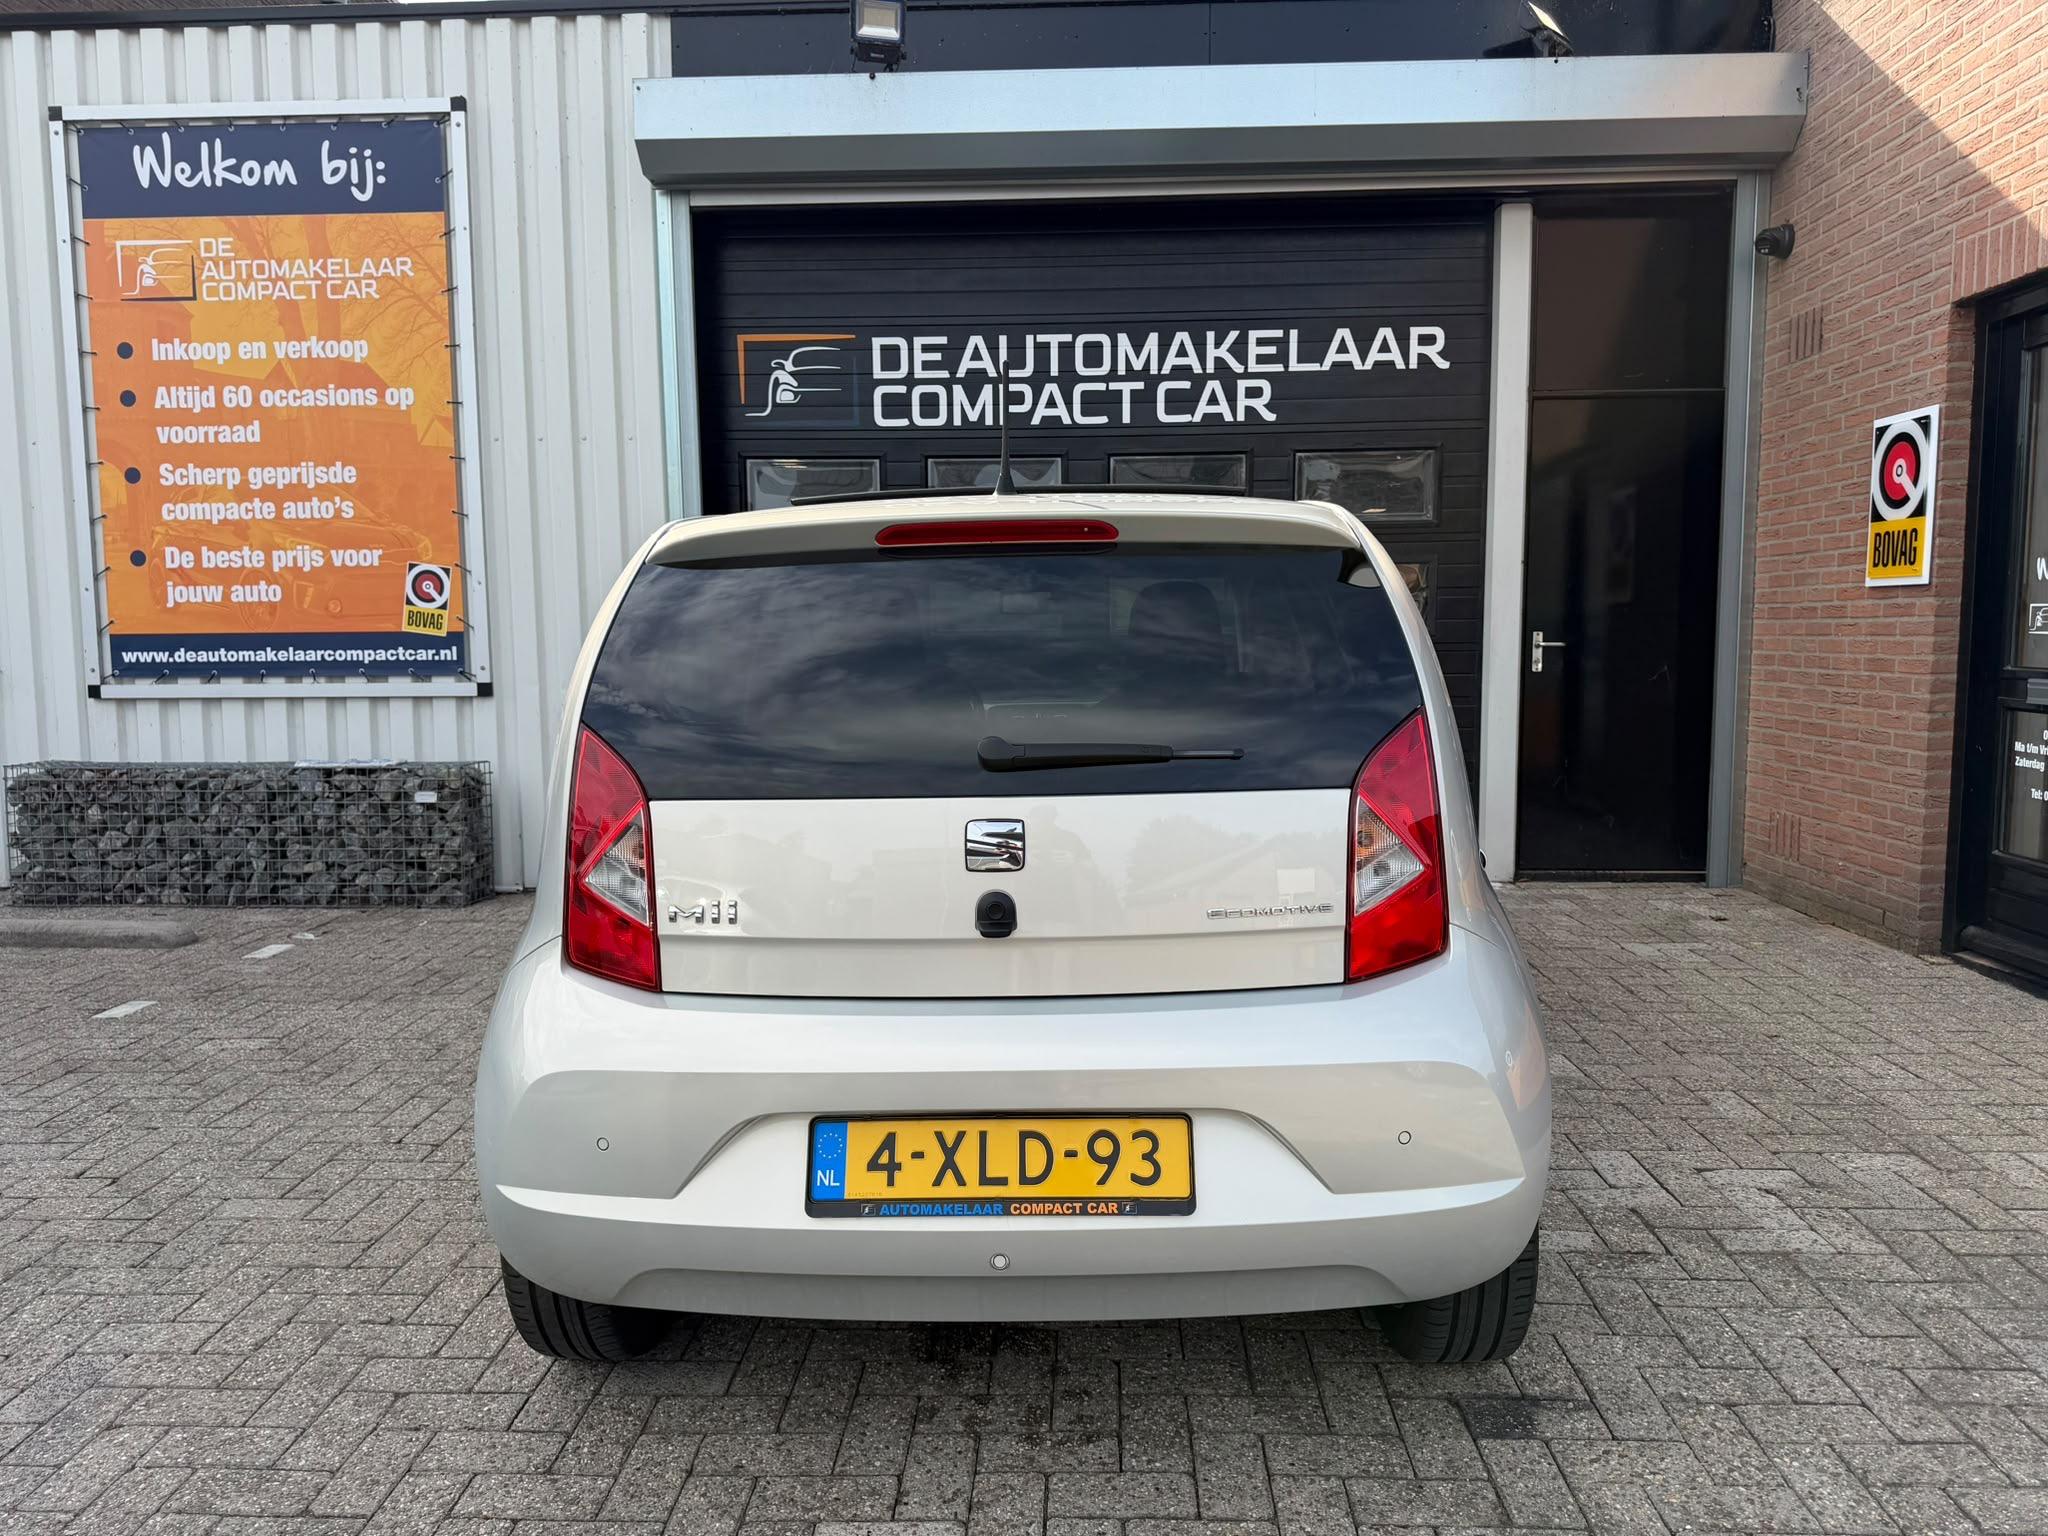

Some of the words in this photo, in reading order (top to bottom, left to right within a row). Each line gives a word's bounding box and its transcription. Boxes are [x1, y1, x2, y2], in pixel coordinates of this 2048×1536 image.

[132, 131, 298, 189] Welkom
[321, 140, 386, 202] bij:
[199, 238, 234, 258] DE
[201, 257, 415, 280] AUTOMAKELAAR
[202, 281, 321, 302] COMPACT
[326, 279, 380, 300] CAR
[151, 337, 231, 365] Inkoop
[238, 342, 267, 360] en
[273, 336, 369, 362] verkoop
[872, 336, 951, 379] DE
[956, 327, 1450, 378] AUTOMAKELAAR
[154, 386, 216, 412] Altijd
[222, 385, 253, 408] 60
[259, 384, 378, 408] occasions
[384, 388, 415, 411] op
[873, 381, 1144, 427] COMPACT
[1157, 379, 1276, 422] CAR
[156, 420, 260, 444] voorraad
[159, 463, 241, 490] Scherp
[248, 462, 357, 490] geprijsde
[162, 498, 275, 525] compacte
[164, 546, 195, 569] De
[201, 546, 265, 569] beste
[272, 545, 325, 573] prijs
[331, 548, 383, 567] voor
[1872, 527, 1918, 568] BOVAG
[166, 581, 223, 608] jouw
[230, 580, 282, 603] auto
[407, 610, 443, 631] BOVAG
[121, 645, 458, 665] www.deautomakelaarcompactcar.nl
[2015, 741, 2025, 752] Ma
[2015, 756, 2045, 772] Zaterdag
[2031, 788, 2043, 800] Tel:
[1207, 903, 1334, 919] ECOMOTIVE
[866, 1129, 1162, 1187] 4-XLD-93
[816, 1169, 840, 1187] NL
[880, 1203, 1004, 1216] AUTOMAKELAAR
[1010, 1202, 1083, 1216] COMPACT
[1087, 1202, 1118, 1214] CAR
